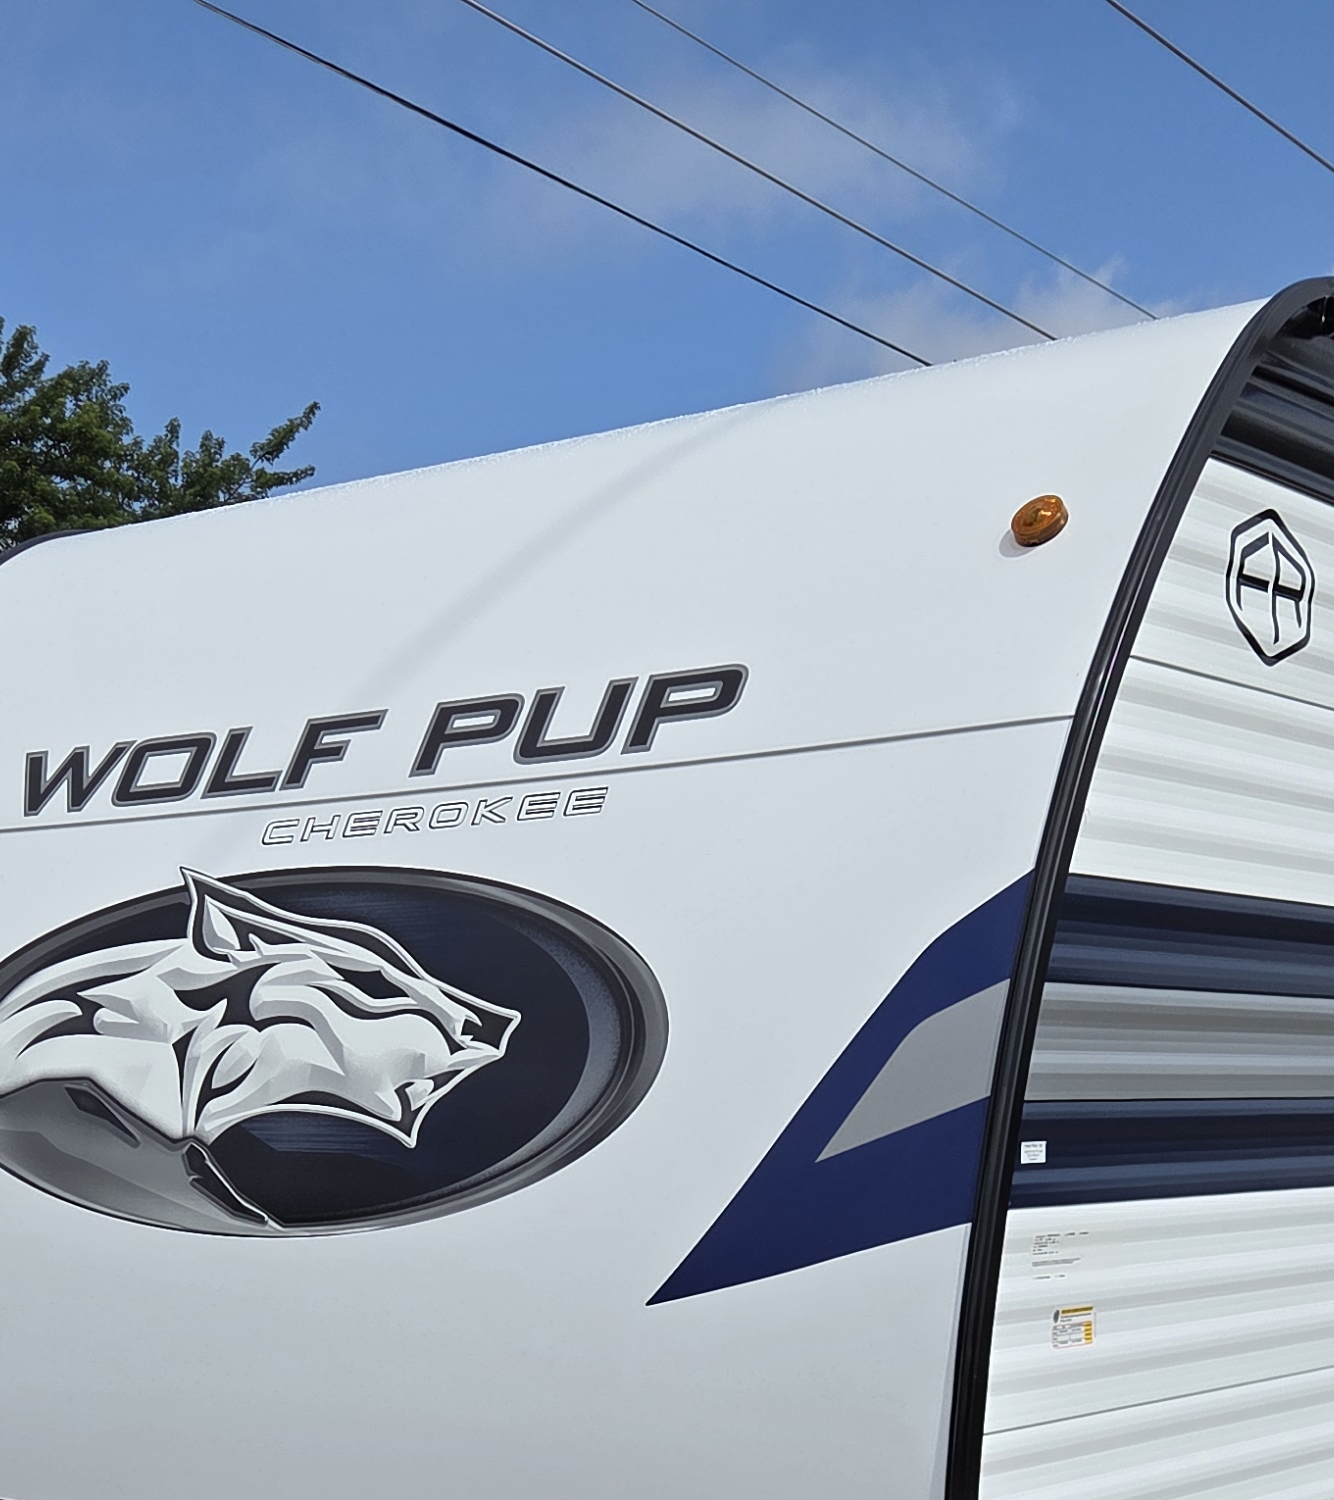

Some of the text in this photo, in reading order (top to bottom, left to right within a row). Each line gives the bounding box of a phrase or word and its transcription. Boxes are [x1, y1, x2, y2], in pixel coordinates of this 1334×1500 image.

[23, 663, 750, 817] WOLF PUP
[261, 786, 609, 846] CHEROKEE
